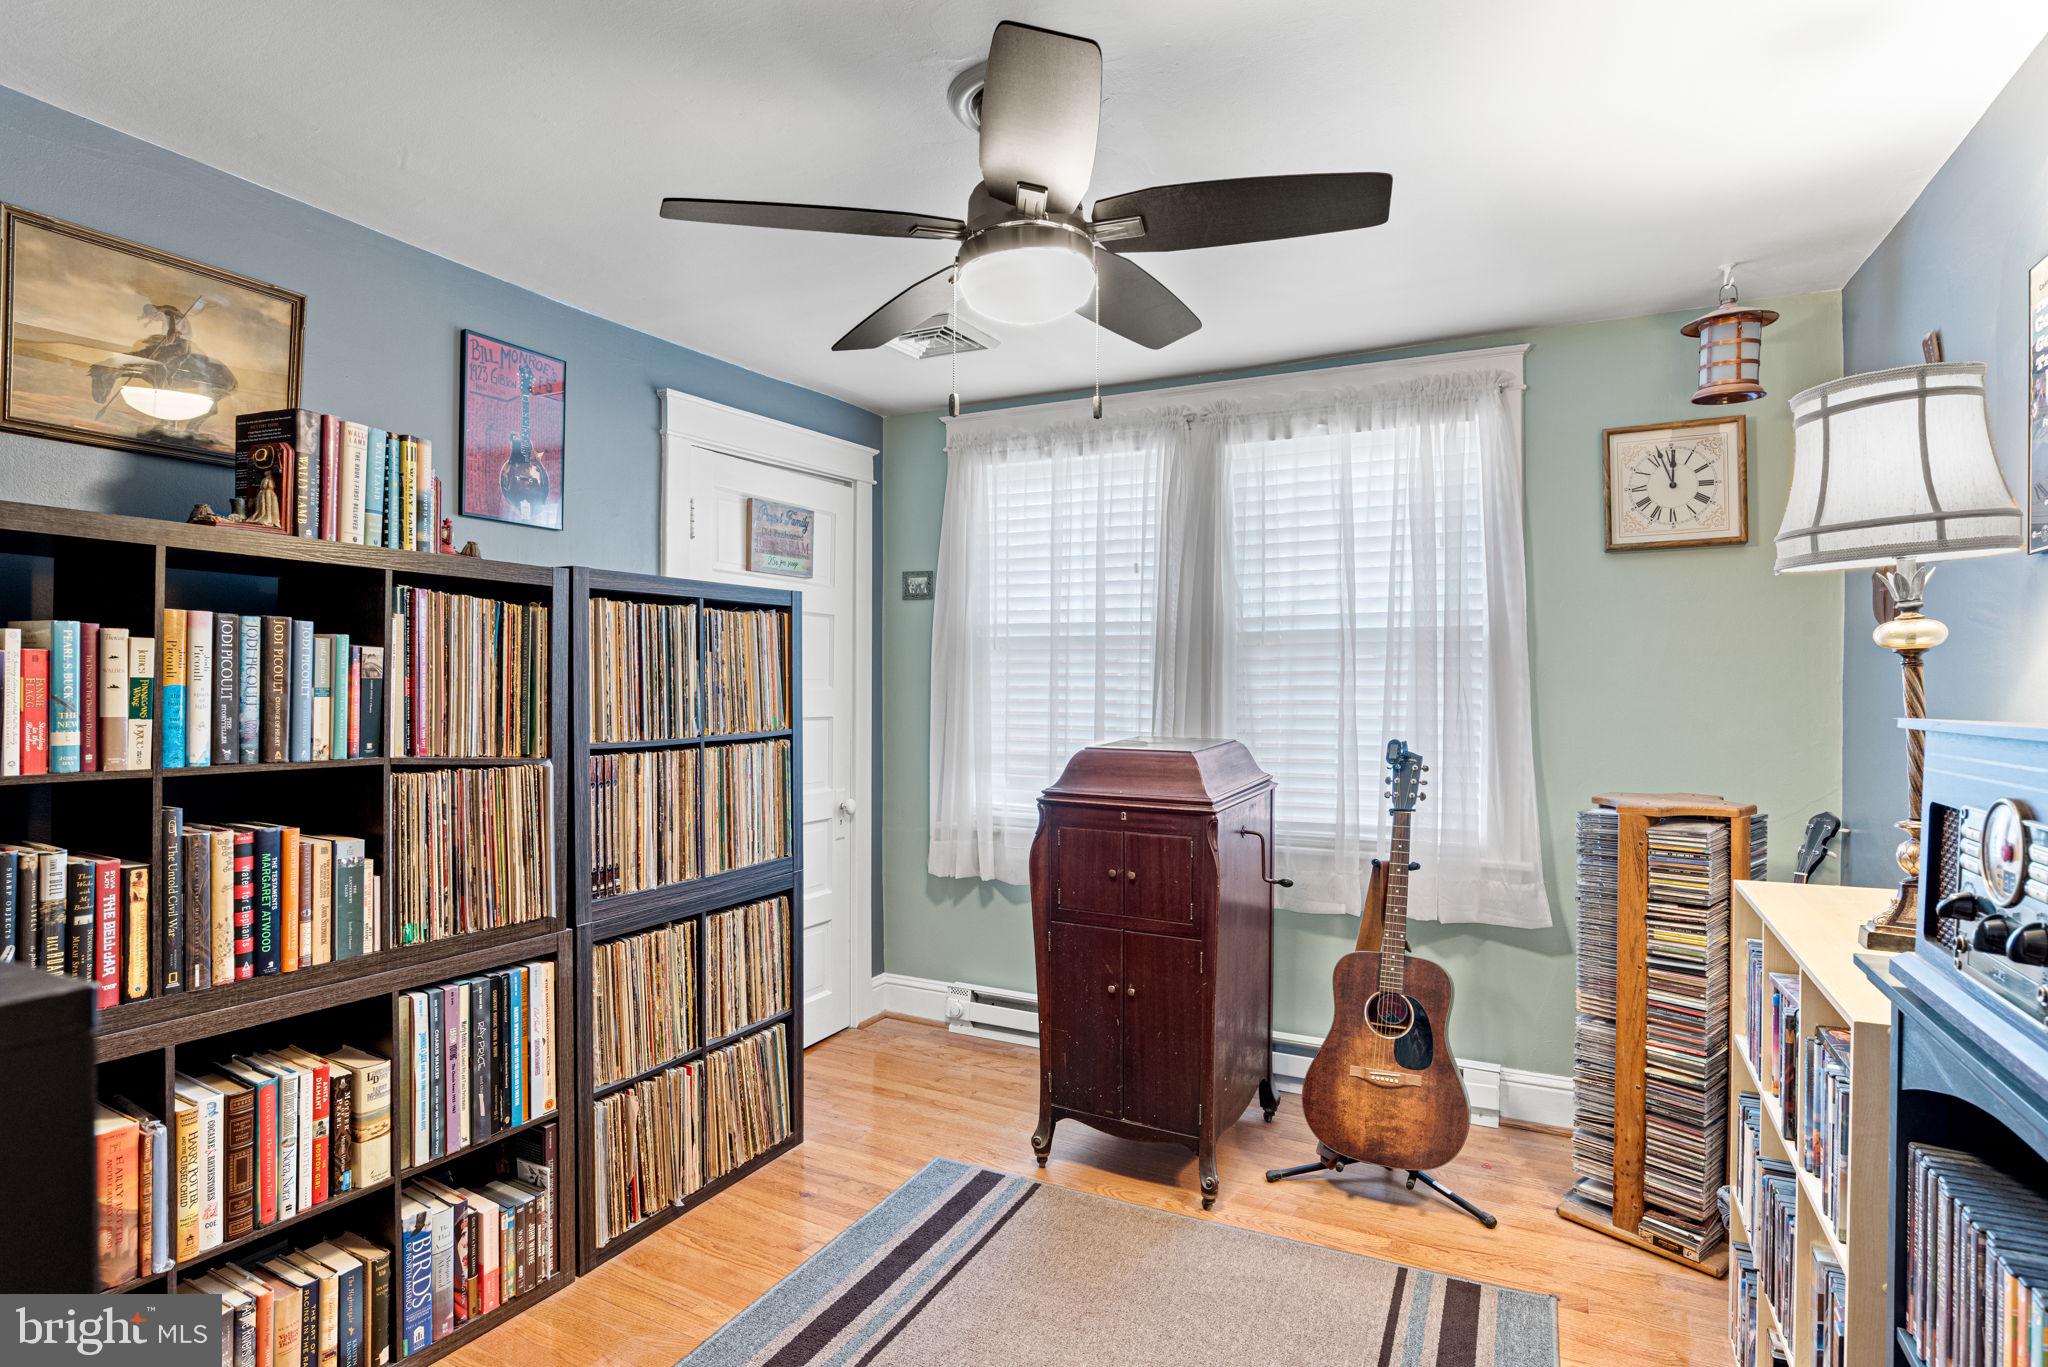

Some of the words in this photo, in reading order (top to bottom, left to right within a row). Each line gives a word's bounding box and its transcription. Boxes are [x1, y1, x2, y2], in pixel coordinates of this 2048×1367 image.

[470, 338, 499, 364] BILL
[470, 362, 489, 383] 1923
[374, 442, 382, 473] WALLY
[298, 456, 308, 493] WALLY
[374, 475, 382, 500] LAMB
[298, 496, 308, 524] LAMB
[63, 630, 73, 658] PEARL
[220, 619, 233, 647] JODI
[246, 623, 258, 651] JODI
[273, 619, 286, 645] JODI
[301, 625, 311, 650] JODI
[166, 640, 178, 678] Picoult
[318, 641, 327, 655] jodi
[63, 660, 73, 671] S.
[194, 645, 204, 681] Picoult
[221, 649, 232, 700] PICOULT
[273, 648, 284, 694] PICOULT
[300, 653, 310, 698] PICOULT
[318, 657, 327, 684] picoult
[25, 677, 35, 708] FLAGG
[35, 678, 46, 708] FANNIE
[64, 673, 73, 699] BUCK
[245, 656, 259, 707] PICOULT
[132, 686, 141, 707] WAKE
[140, 680, 149, 718] FINNEGANS
[25, 721, 33, 752] Rainbow
[37, 721, 46, 751] Standing
[134, 724, 146, 749] Joyce
[168, 843, 177, 862] The
[49, 872, 63, 896] O'DELL
[168, 864, 178, 894] Untold
[241, 864, 252, 884] Water
[262, 853, 271, 907] MARGARET
[103, 894, 116, 919] THE
[168, 896, 178, 917] Civil
[241, 892, 251, 903] for
[103, 921, 116, 951] BELL
[168, 920, 177, 938] War
[241, 906, 251, 947] Elephants
[261, 911, 271, 952] ATWOOD
[46, 936, 59, 952] BACK
[72, 936, 80, 958] MICAH
[102, 952, 115, 978] JAR
[476, 1021, 486, 1040] RAY
[450, 1044, 458, 1061] YOUNG
[477, 1041, 485, 1071] PRICE
[207, 1120, 215, 1149] COCAINE
[188, 1132, 198, 1169] HARRY
[281, 1149, 294, 1177] Nora,
[114, 1156, 124, 1198] HARRY
[180, 1156, 188, 1183] CURSED
[207, 1156, 215, 1202] RHINESTONES
[180, 1185, 188, 1207] CHILD
[187, 1169, 198, 1209] POTTER
[283, 1176, 293, 1201] Nora
[114, 1202, 123, 1246] POTTER
[205, 1220, 217, 1229] COE
[406, 1243, 412, 1251] OF
[413, 1236, 431, 1308] BIRDS
[241, 1330, 254, 1356] Rivers
[303, 1325, 309, 1334] IN
[310, 1343, 316, 1354] OF
